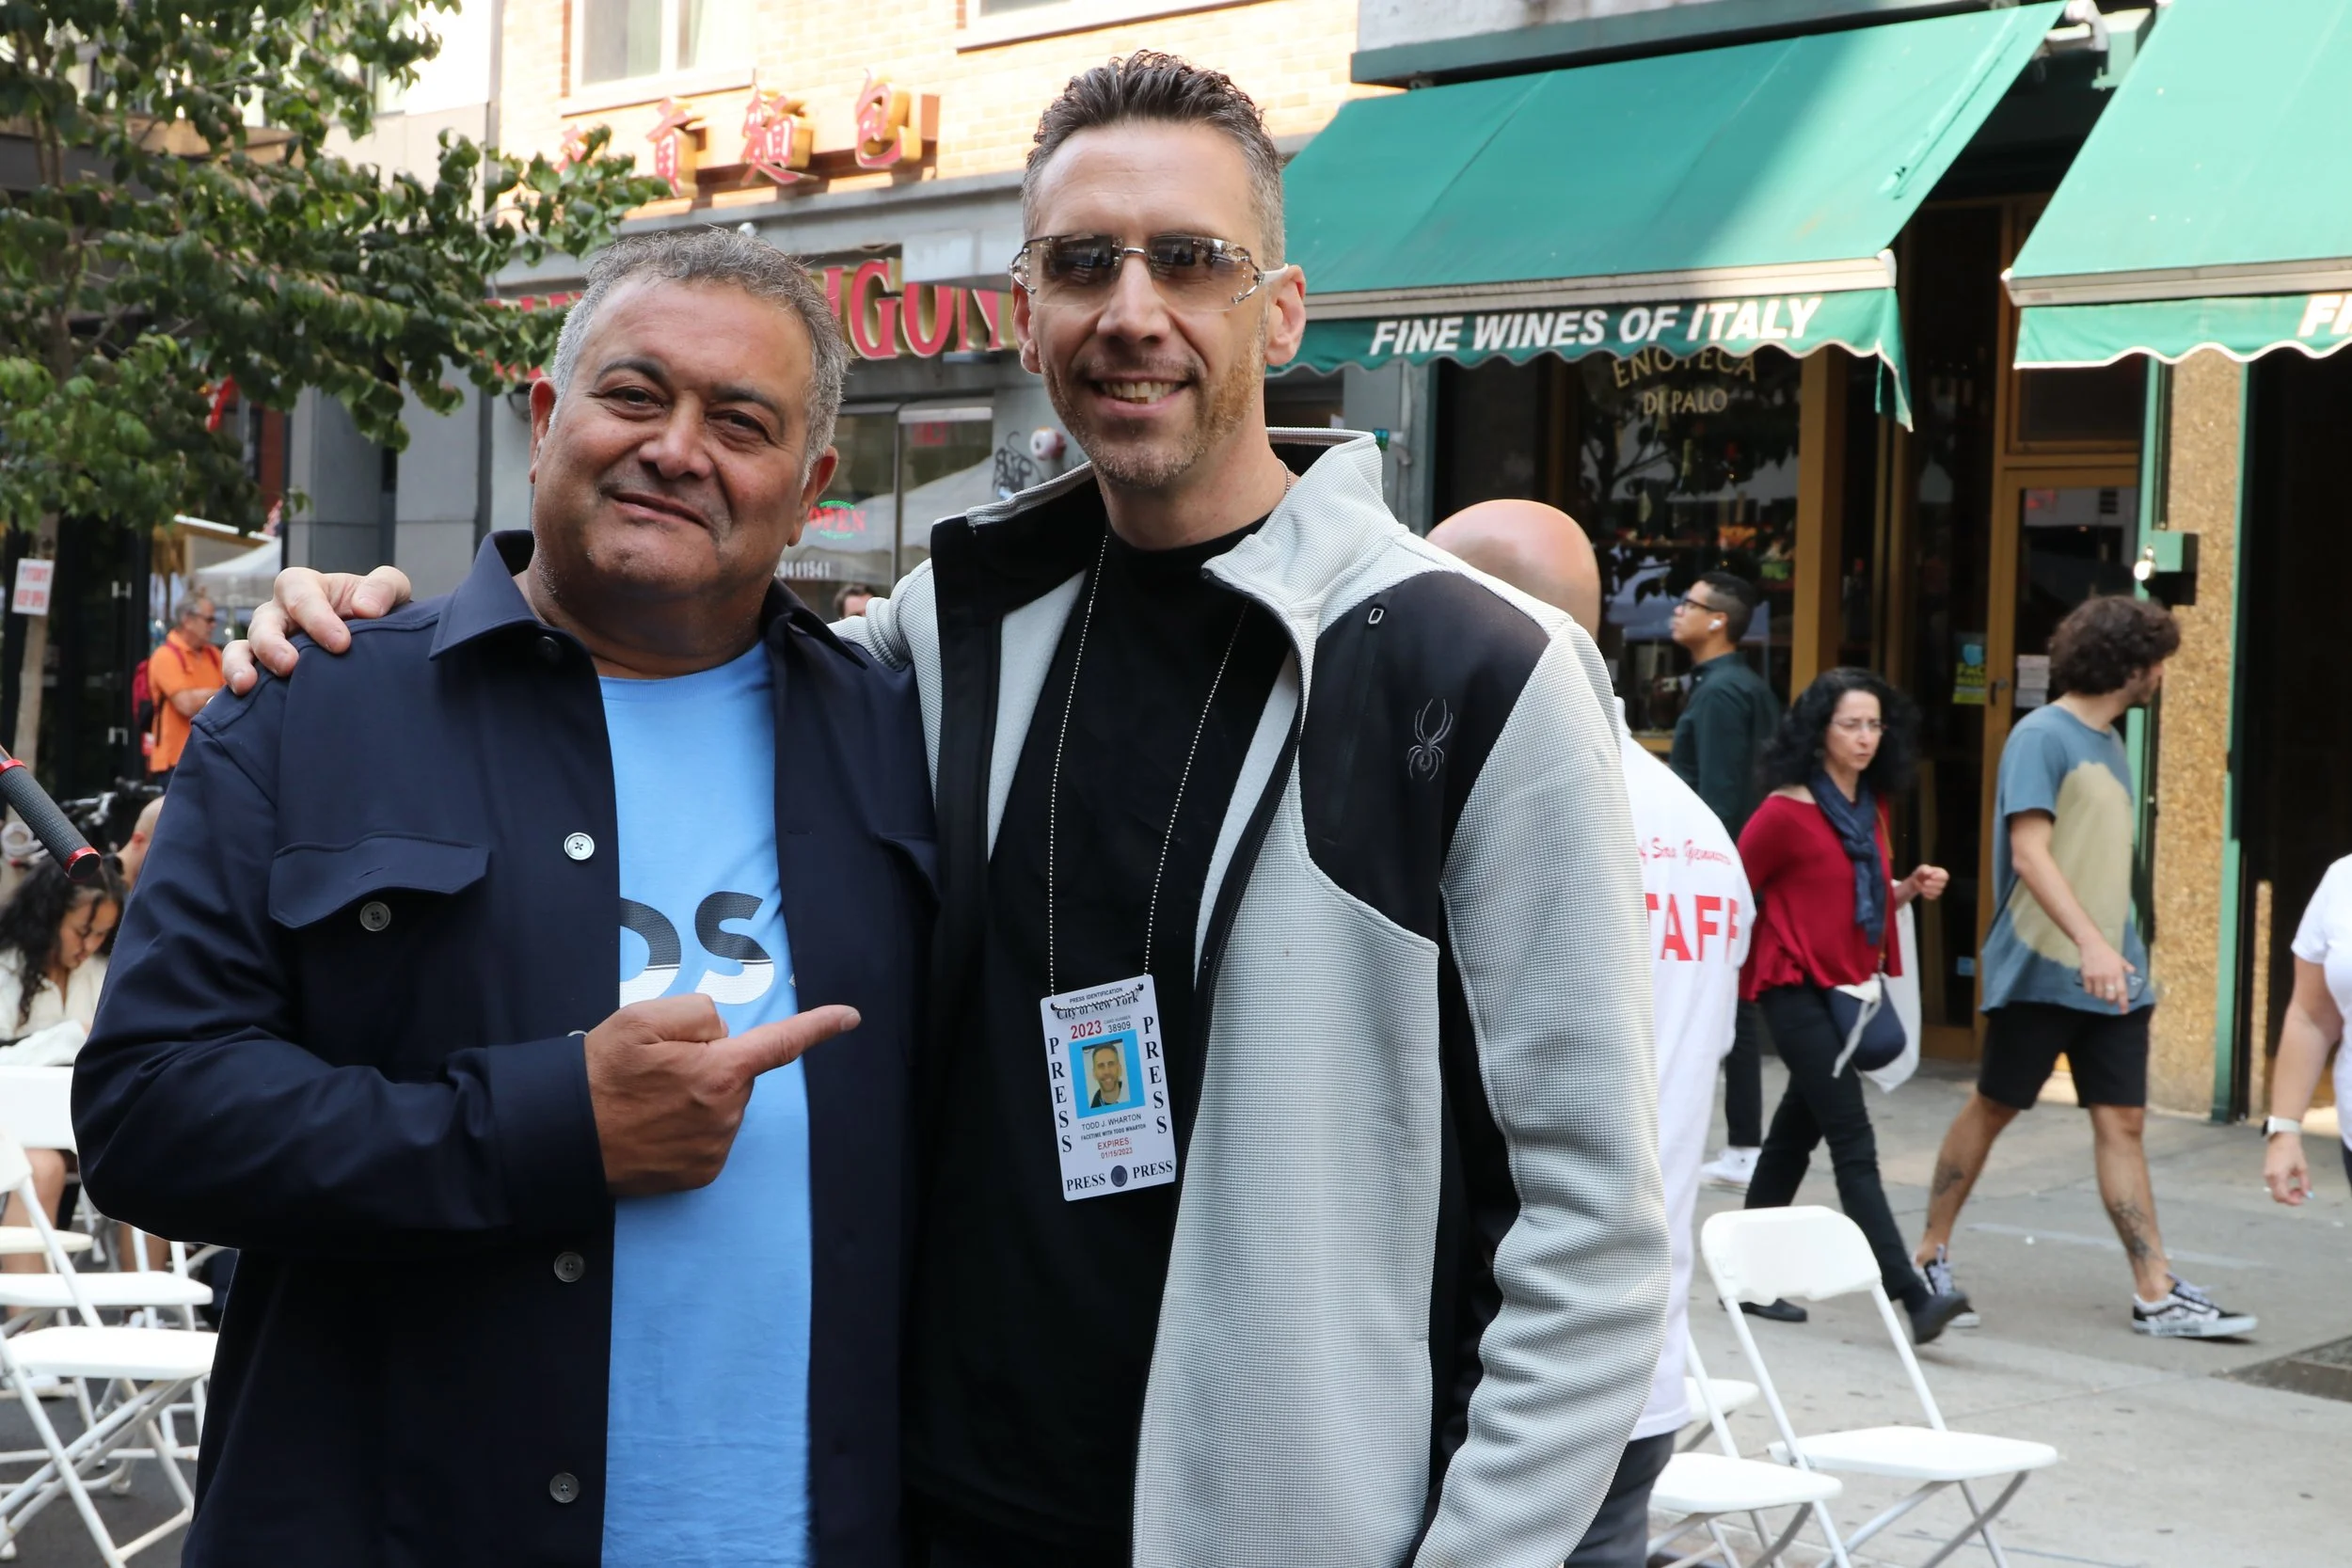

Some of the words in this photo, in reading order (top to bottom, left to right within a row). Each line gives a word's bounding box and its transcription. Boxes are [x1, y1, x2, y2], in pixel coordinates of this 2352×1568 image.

[1370, 317, 1465, 356] FINE
[1473, 309, 1605, 351] WINES
[1618, 306, 1679, 342] OF
[1687, 297, 1823, 341] ITALY
[2296, 293, 2352, 337] FI
[1643, 390, 1664, 415] DI
[1671, 388, 1728, 414] PALO
[808, 506, 866, 533] OPEN
[1057, 1007, 1076, 1020] City
[1112, 990, 1139, 1006] York
[1069, 995, 1086, 1004] PRESS
[1086, 987, 1123, 1000] IDENTIFICATION
[1070, 1020, 1103, 1039] 2023
[1107, 1021, 1132, 1034] 38909
[1142, 1016, 1168, 1134] PRESS
[1049, 1037, 1073, 1153] PRESS
[1081, 1121, 1100, 1131] TODD
[1107, 1113, 1142, 1126] WHARTON
[1080, 1132, 1102, 1140] FACETIME
[1097, 1137, 1133, 1149] EXPIRES:
[1065, 1173, 1106, 1192] PRESS
[1133, 1160, 1173, 1179] PRESS
